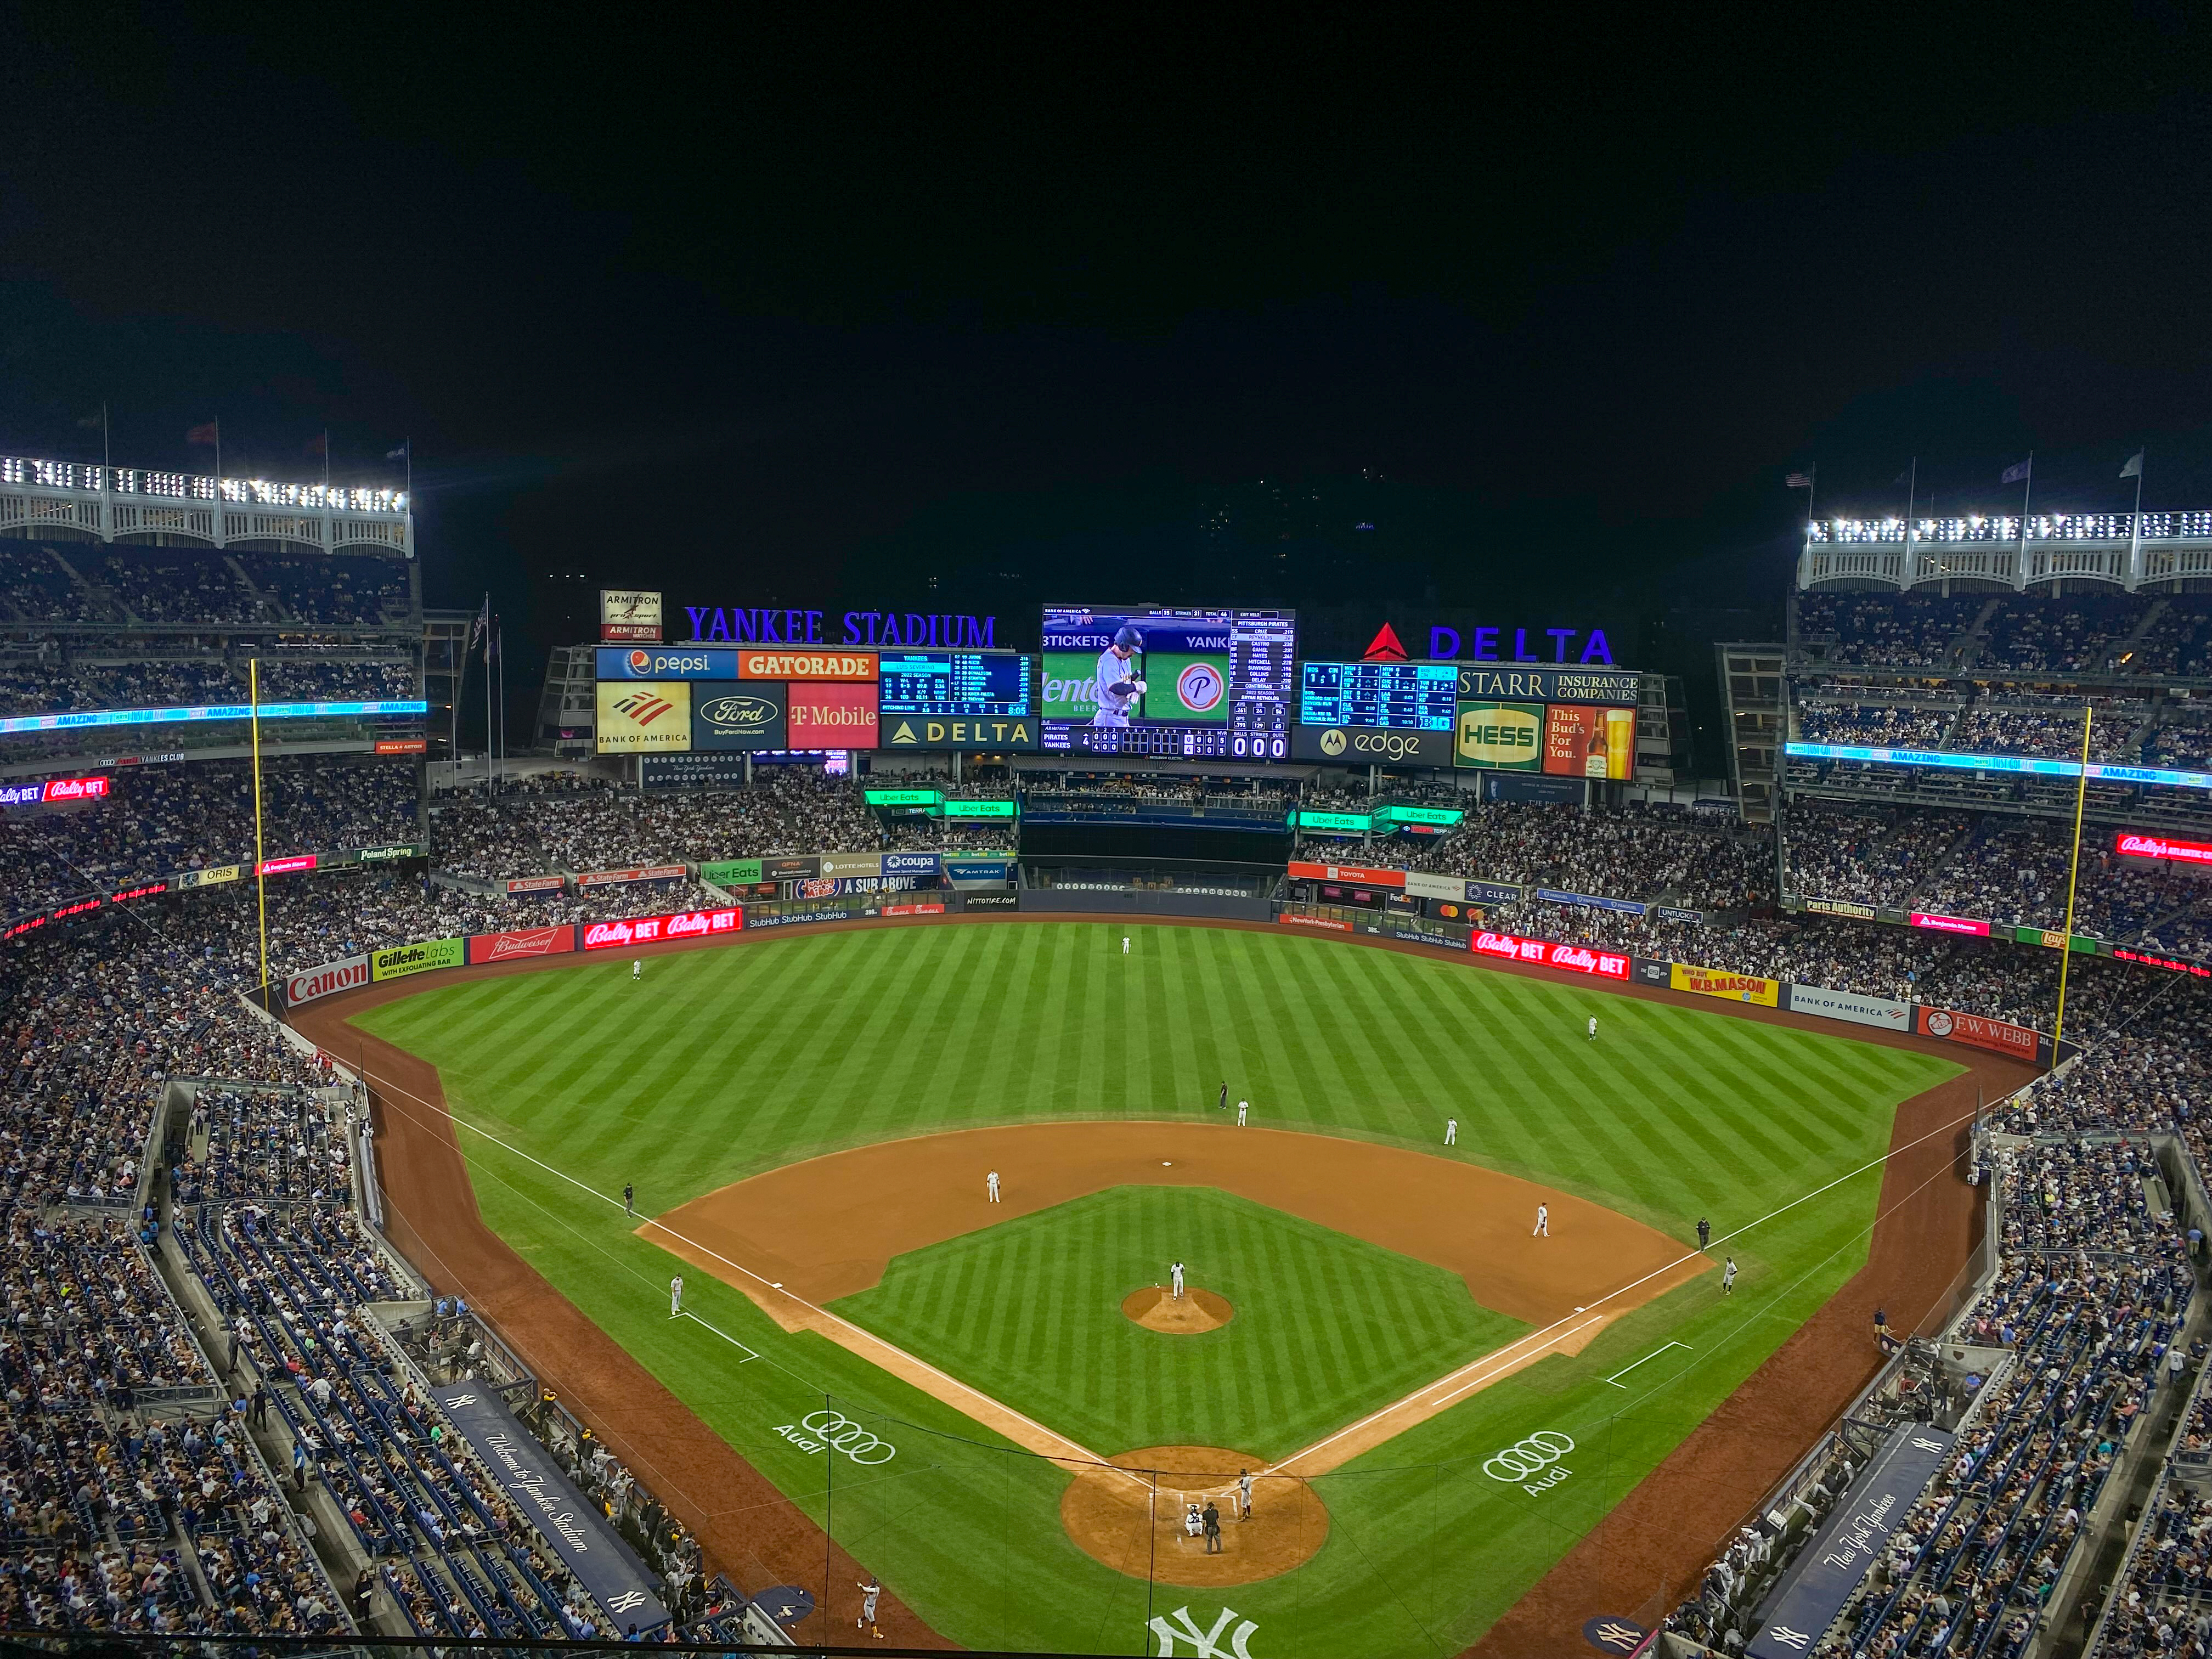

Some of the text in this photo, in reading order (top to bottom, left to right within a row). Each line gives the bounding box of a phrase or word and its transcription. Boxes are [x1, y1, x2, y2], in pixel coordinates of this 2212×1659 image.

[607, 596, 658, 605] ARMITRON
[684, 607, 996, 648] YANKEE STADIUM
[1430, 626, 1616, 664] DELTA
[655, 654, 708, 674] pepsi
[748, 656, 869, 675] GATORADE
[1458, 672, 1638, 697] STARR INSURANCE
[1558, 687, 1637, 701] COMPANIES
[207, 708, 250, 717] AMAZING
[714, 700, 765, 722] Ford
[811, 707, 876, 725] Mobile
[1551, 709, 1580, 721] This
[57, 715, 97, 725] AMAZING
[1551, 722, 1585, 734] Bud's
[644, 734, 687, 742] AMERICA
[927, 722, 1029, 742] DELTA
[1465, 725, 1534, 747] HESS
[1551, 734, 1571, 746] For
[1234, 738, 1283, 757] 0 0 0
[1355, 730, 1420, 761] edge
[1550, 746, 1576, 759] You.
[141, 754, 168, 763] YANKEES
[1892, 752, 1941, 763] AMAZING
[2102, 768, 2157, 780] AMAZING
[21, 787, 38, 800] BET
[51, 781, 84, 797] Bally
[1334, 817, 1355, 826] Eats
[1407, 811, 1425, 819] Uber
[361, 848, 412, 860] Poland Spring
[2121, 837, 2166, 856] Bally's
[901, 857, 934, 868] coupa
[208, 868, 232, 879] ORIS
[704, 868, 759, 881] Uber Eats
[845, 876, 916, 894] A SUB ABOVE
[1390, 894, 1411, 903] FedEx
[1486, 890, 1517, 901] CLEAR
[1662, 909, 1694, 920] UNTUCKit
[1807, 900, 1831, 910] Parts
[1832, 902, 1875, 917] Authority
[749, 911, 847, 928] StubHub StubHub StubHub
[1931, 920, 1957, 928] Benjamin
[588, 912, 735, 945] Bally BET Bally BET
[495, 938, 550, 952] Budweiser
[1396, 932, 1466, 949] StubHub StubHub StubHub
[379, 947, 425, 968] Gillette
[1477, 932, 1626, 974] Bally BET Bally BET
[382, 968, 398, 977] WITH
[398, 961, 436, 973] EXFOLIATING
[289, 963, 366, 1001] Canon
[1795, 995, 1883, 1017] BANK OF AMERICA
[1955, 1017, 1984, 1035] F.W.
[1988, 1023, 2031, 1047] WEBB
[772, 1425, 826, 1455] Audi
[1522, 1466, 1573, 1497] Audi
[485, 1433, 588, 1553] Welcome to Yankee Stadium
[1823, 1493, 1897, 1570] New York Yankees
